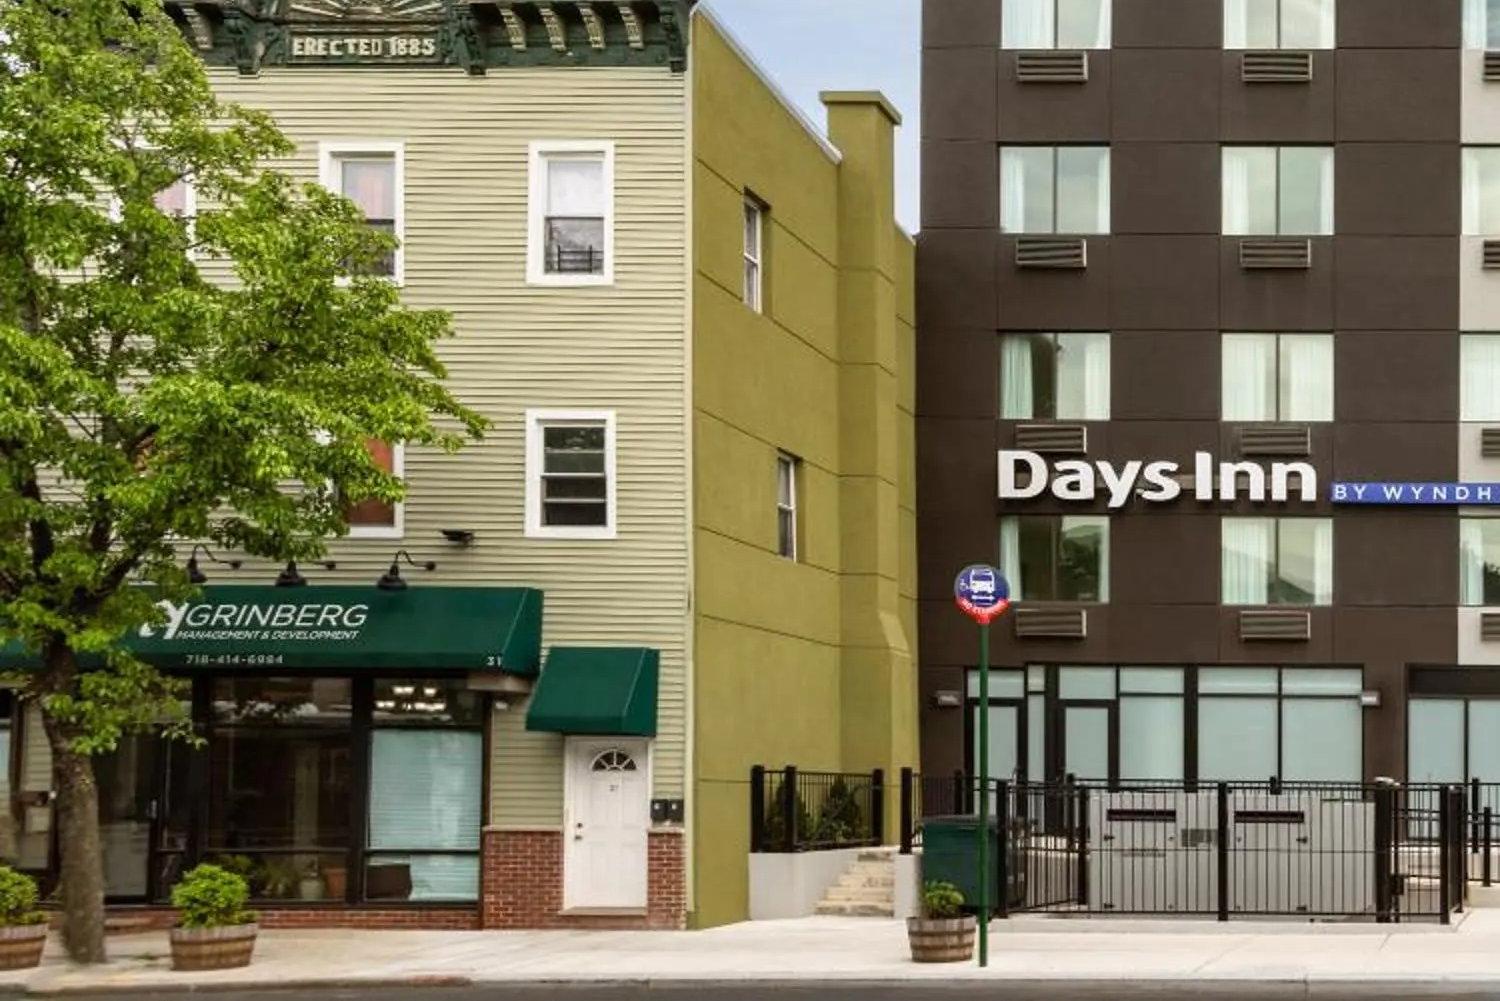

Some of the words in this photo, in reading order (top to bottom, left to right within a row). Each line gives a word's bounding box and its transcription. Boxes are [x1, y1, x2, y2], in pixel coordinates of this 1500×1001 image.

[293, 37, 382, 56] ERECTED
[384, 36, 436, 57] 1885
[997, 450, 1181, 507] Days
[1195, 451, 1318, 501] Inn
[1334, 485, 1367, 500] BY
[185, 604, 369, 627] GRINBERG
[175, 630, 261, 640] MANAGEMENT
[261, 630, 270, 640] &
[271, 630, 361, 640] DEVELOPMENT
